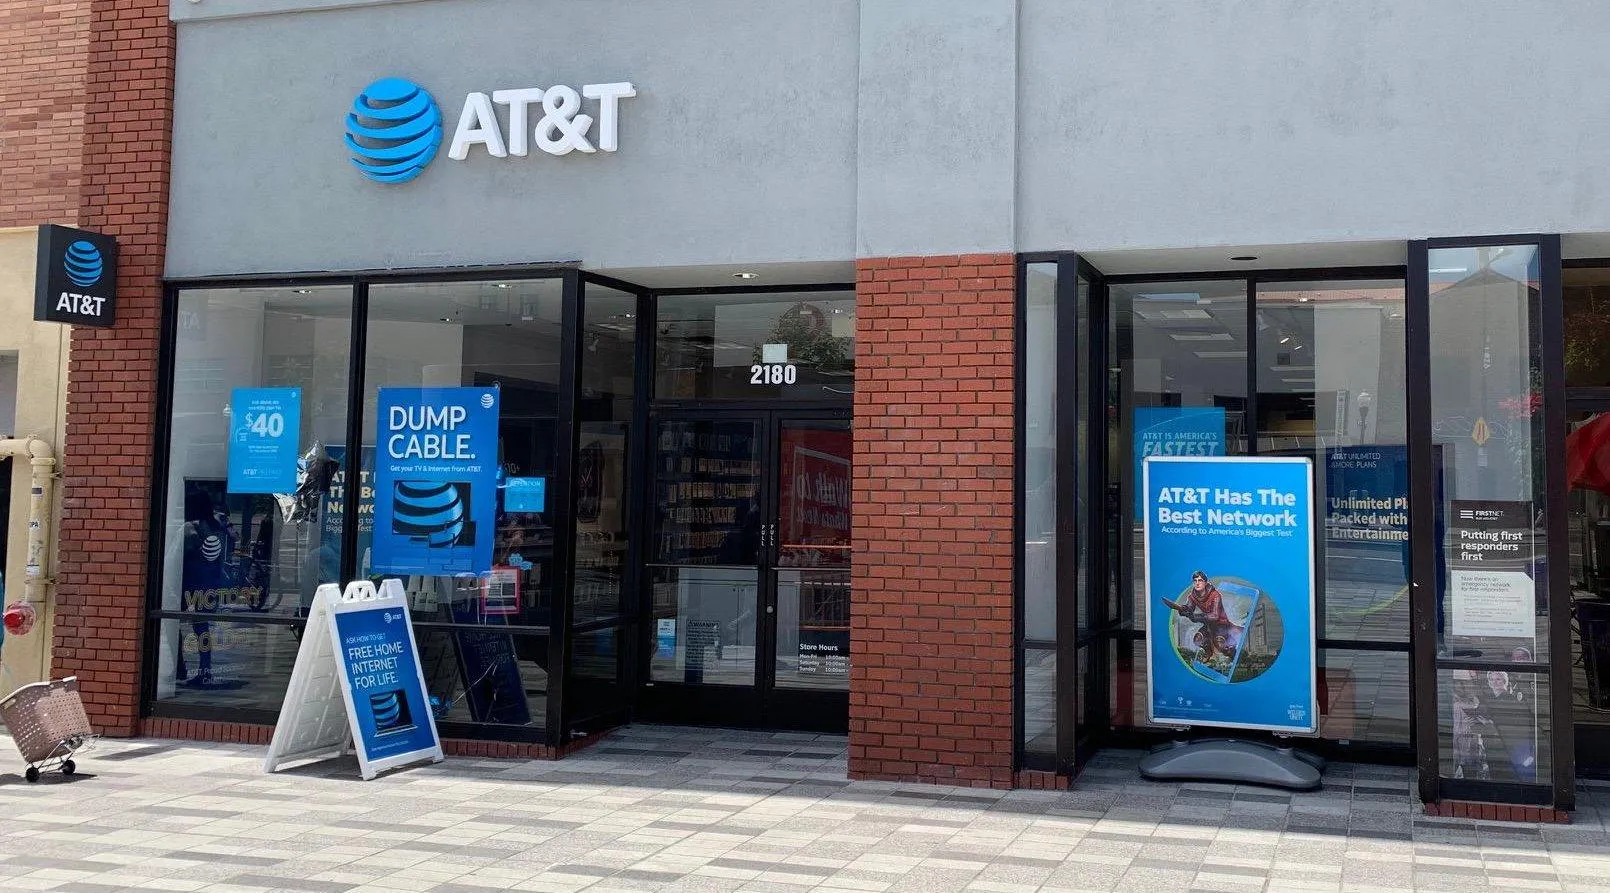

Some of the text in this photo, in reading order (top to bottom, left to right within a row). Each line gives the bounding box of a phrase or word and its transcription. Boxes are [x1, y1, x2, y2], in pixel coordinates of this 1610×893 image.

[448, 82, 637, 161] AT&T
[56, 292, 106, 317] AT&T
[750, 364, 797, 385] 2180
[245, 412, 285, 438] $40
[389, 405, 467, 431] DUMP
[1143, 432, 1217, 440] AT&T IS AMERICA'S
[388, 434, 476, 460] CABLE.
[1142, 441, 1219, 457] FASTEST
[1158, 487, 1297, 507] AT&T Has The
[1331, 497, 1392, 510] Unlimited
[1158, 507, 1298, 527] Best Network
[1331, 512, 1408, 525] Packed with
[1161, 526, 1197, 536] According
[1198, 527, 1208, 535] to
[1208, 527, 1244, 536] America's
[1245, 528, 1275, 538] Biggest
[1332, 527, 1409, 540] Entertainme
[1461, 530, 1523, 541] Putting first
[1461, 542, 1519, 552] responders
[1461, 552, 1484, 561] first
[346, 636, 357, 645] ASK
[356, 635, 370, 643] HOW
[348, 641, 404, 661] FREE HOME
[352, 656, 398, 675] INTERNET
[354, 675, 377, 690] FOR
